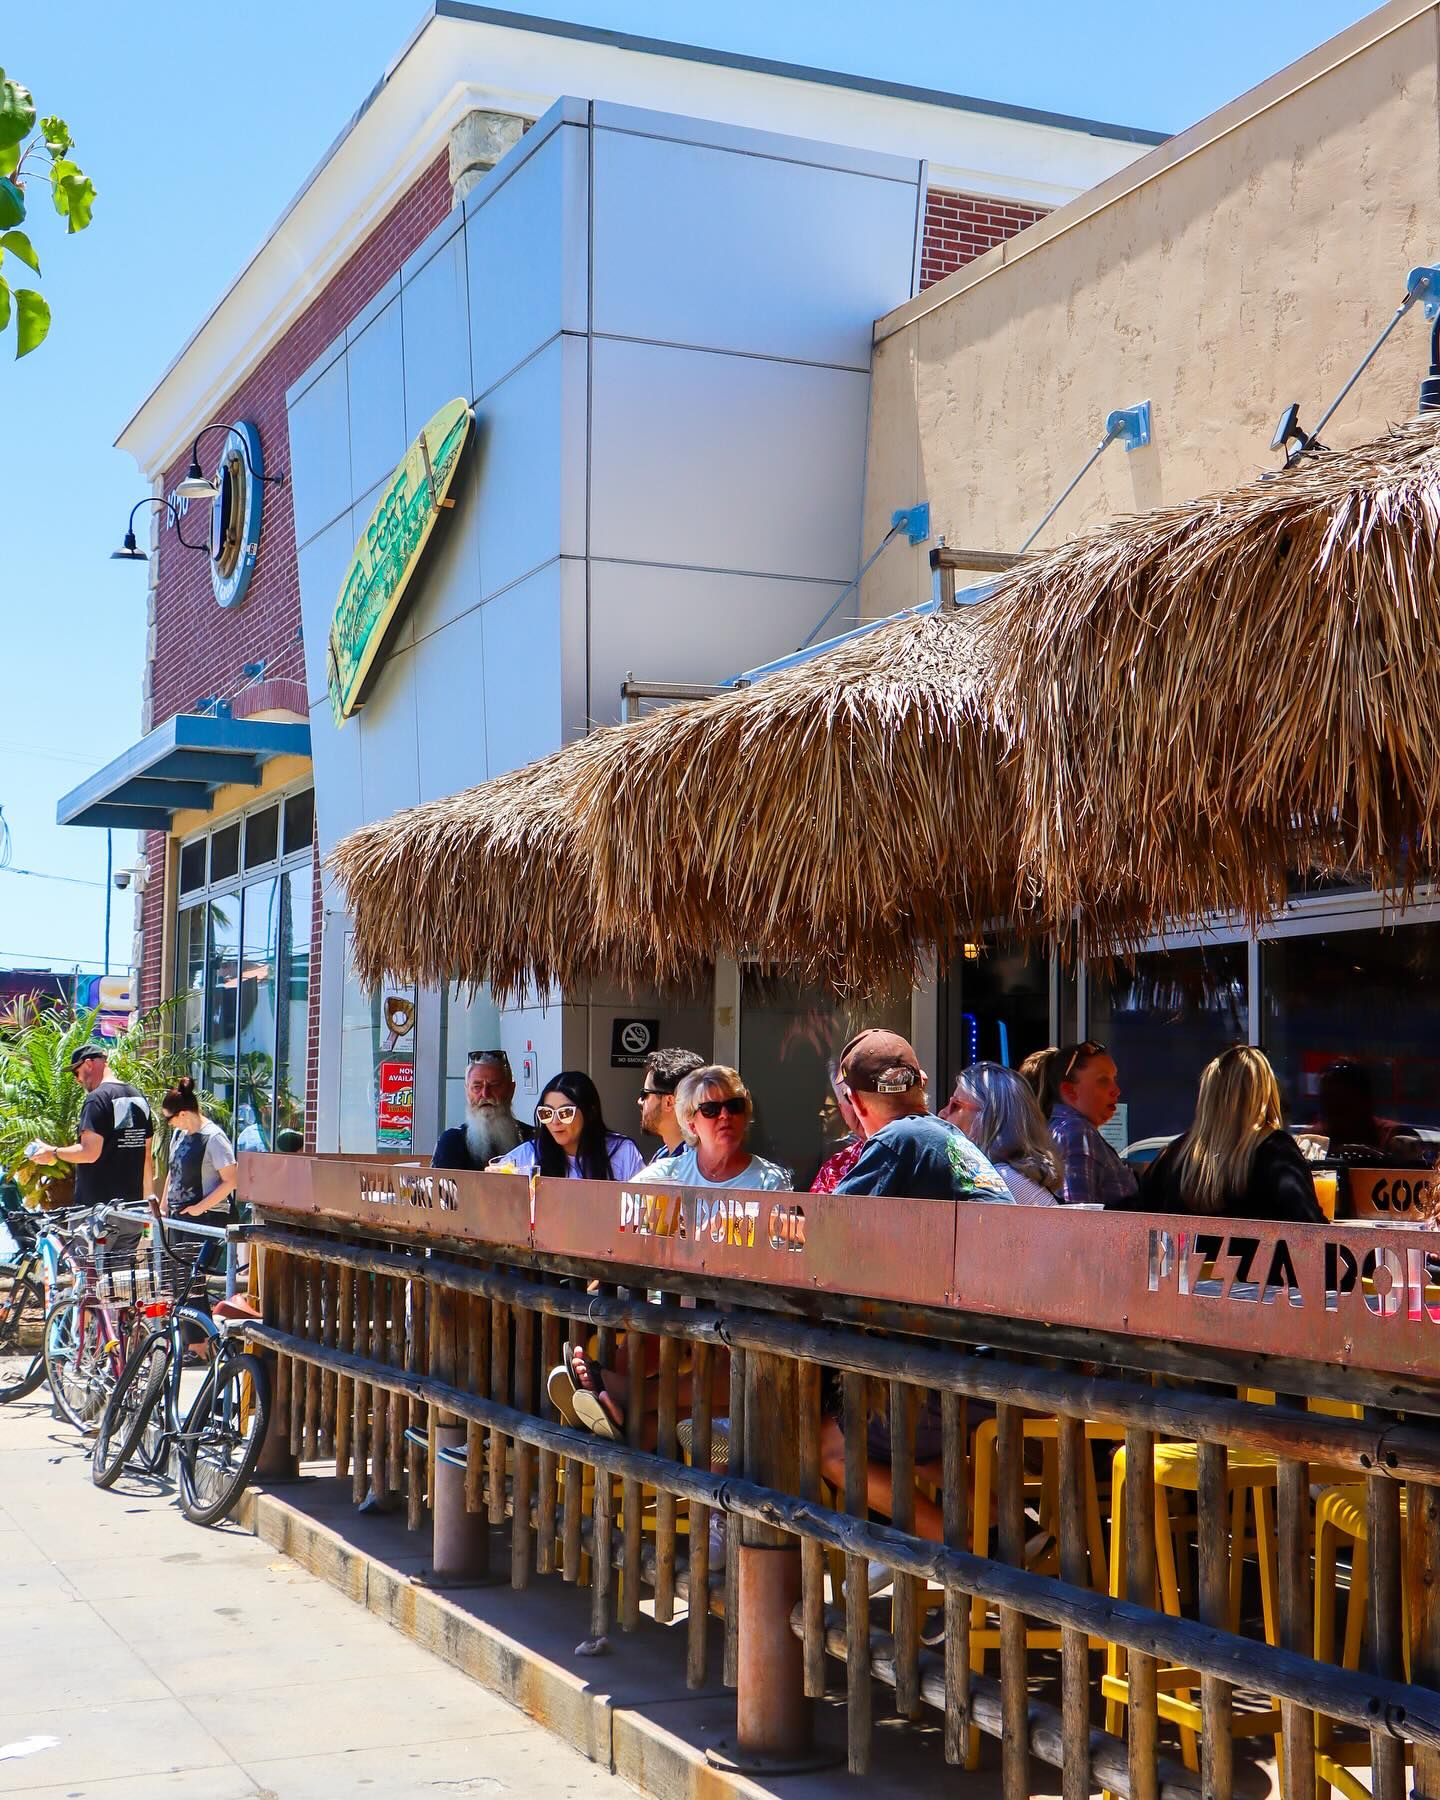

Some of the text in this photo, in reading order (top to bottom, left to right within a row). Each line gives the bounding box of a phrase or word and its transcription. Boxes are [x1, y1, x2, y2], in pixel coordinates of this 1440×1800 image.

[387, 1090, 412, 1105] JET
[619, 1191, 687, 1239] PIZZA
[694, 1198, 760, 1248] PORT
[1148, 1229, 1304, 1308] PIZZA
